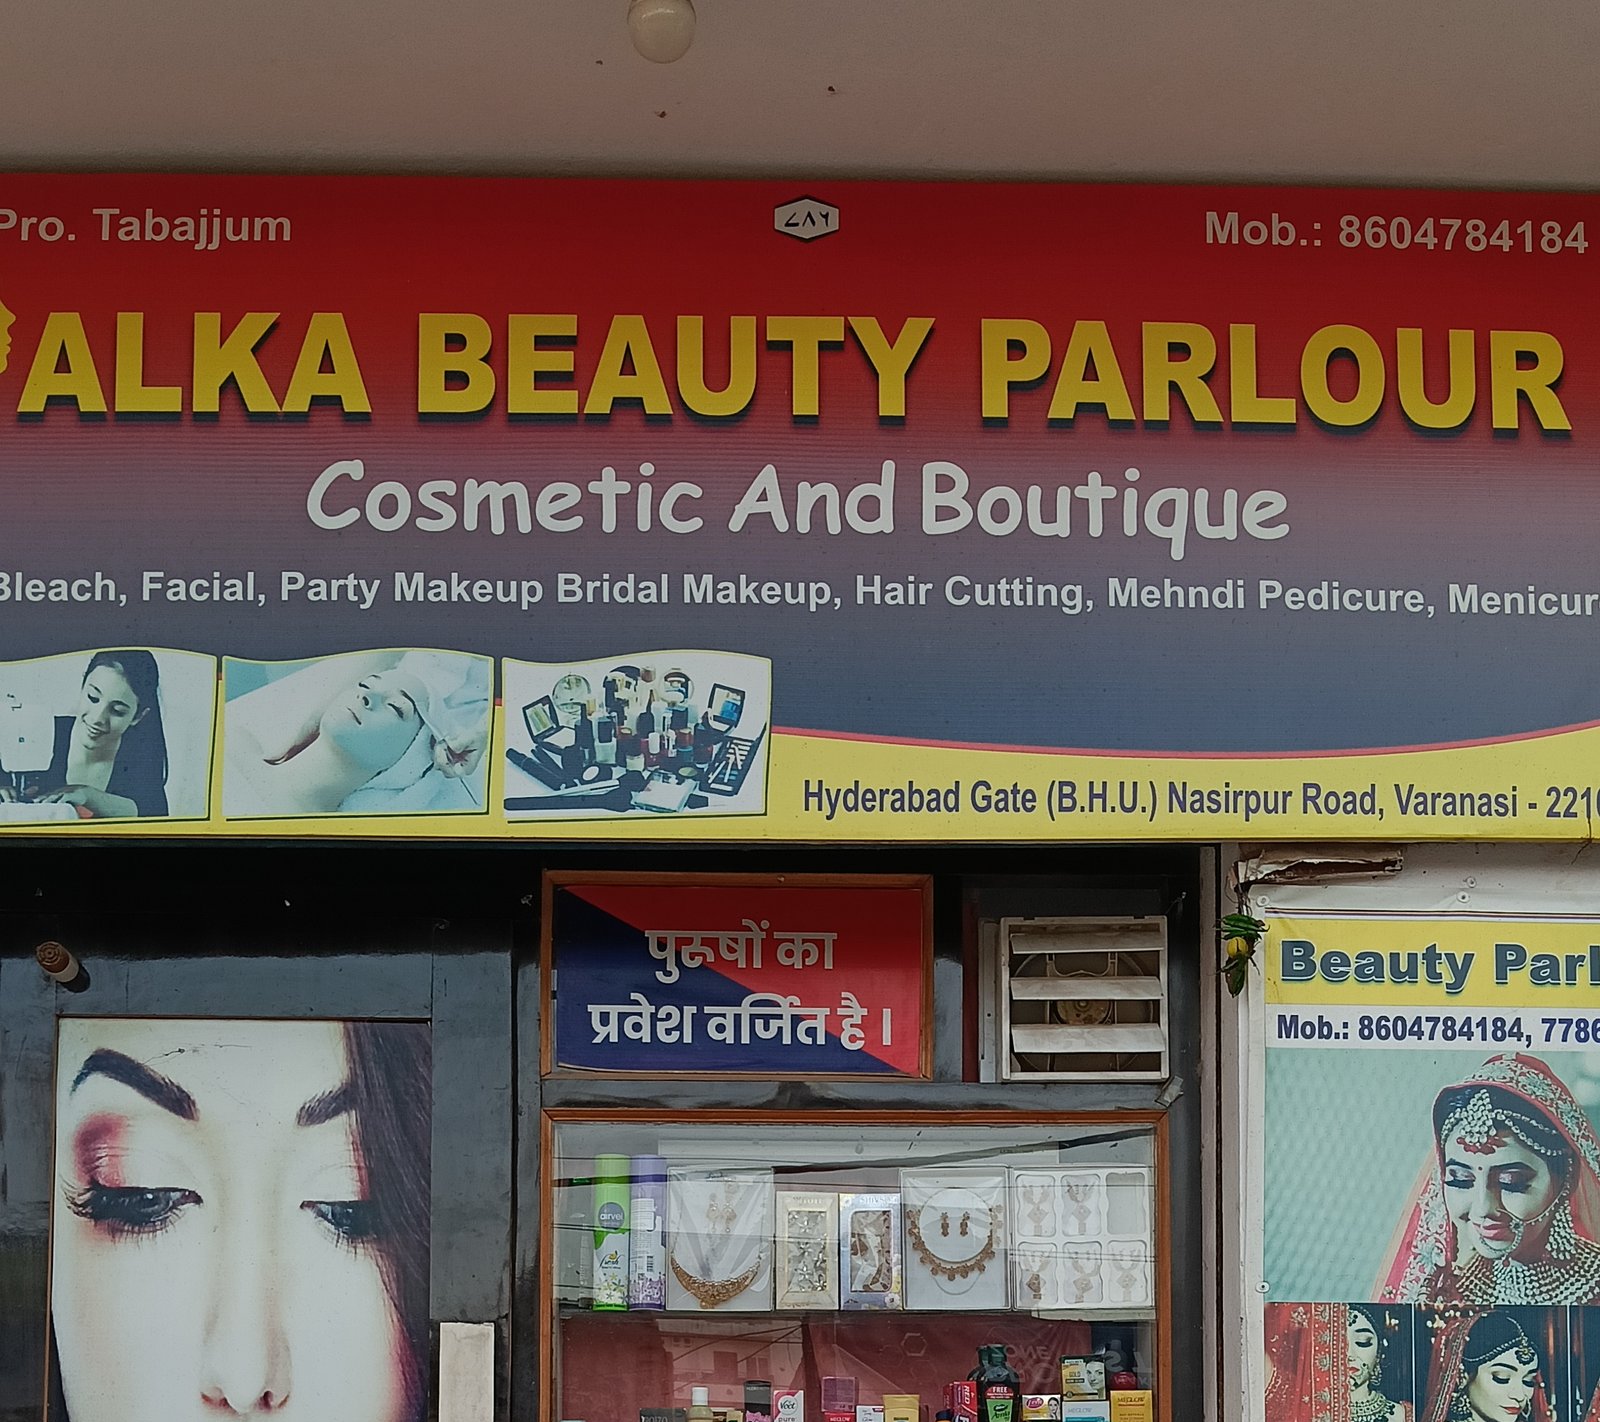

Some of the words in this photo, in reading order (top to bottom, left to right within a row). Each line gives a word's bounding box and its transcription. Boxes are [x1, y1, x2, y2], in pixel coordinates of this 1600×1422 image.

[0, 208, 75, 242] Pro.
[93, 207, 293, 250] Tabajjum
[1205, 211, 1322, 247] Mob.:
[1338, 214, 1590, 254] 8604784184
[17, 311, 373, 417] ALKA
[418, 312, 936, 421] BEAUTY
[980, 317, 1574, 434] PARLOUR
[306, 459, 705, 536] Cosmetic
[728, 460, 896, 537] And
[922, 461, 1291, 561] Boutique
[142, 571, 266, 607] Facial,
[281, 571, 381, 609] Party
[394, 572, 544, 610] Makeup
[557, 572, 669, 604] Bridal
[683, 573, 842, 612] Makeup,
[855, 574, 933, 606] Hair
[945, 575, 1094, 615] Cutting,
[1108, 577, 1246, 609] Mehndi
[1259, 579, 1435, 618] Pedicure,
[1449, 583, 1600, 616] Menicur
[804, 779, 960, 821] Hyderabad
[970, 780, 1037, 814] Gate
[1047, 779, 1157, 822] (B.H.U.)
[1167, 781, 1293, 822] Nasirpur
[1302, 782, 1385, 822] Road,
[1394, 784, 1518, 818] Varanasi
[1546, 786, 1600, 819] 221
[774, 932, 838, 970] का
[1281, 939, 1476, 994] Beauty
[1495, 943, 1600, 986] Parl
[587, 992, 698, 1045] प्रवेश
[704, 992, 830, 1046] वर्जित
[1277, 1014, 1350, 1040] Mob.:
[1358, 1015, 1533, 1049] 8604784184,
[1541, 1017, 1600, 1044] 7786
